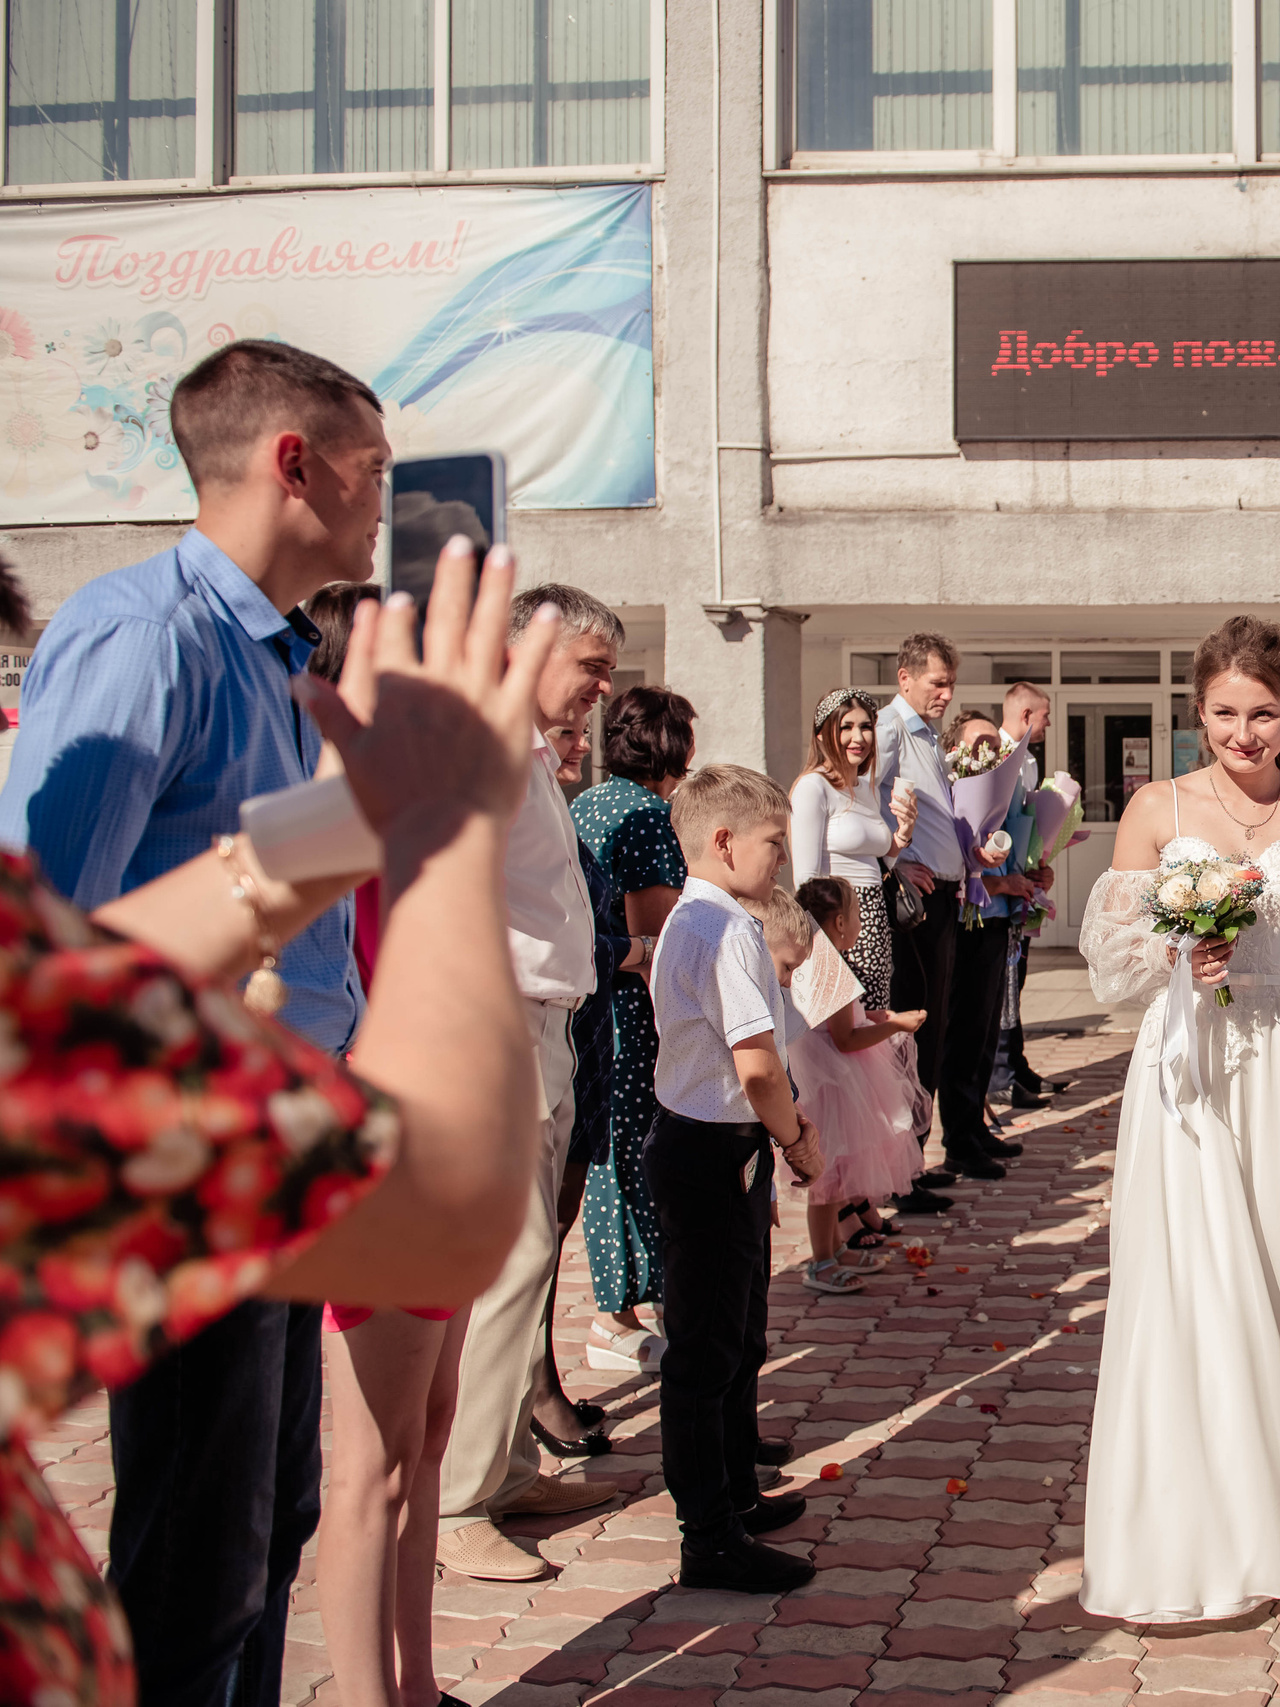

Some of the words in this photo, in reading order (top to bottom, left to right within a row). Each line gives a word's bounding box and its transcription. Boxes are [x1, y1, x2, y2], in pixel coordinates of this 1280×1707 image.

[55, 220, 467, 296] Поздравляем!
[991, 330, 1160, 376] Добро
[0, 673, 21, 687] :00
